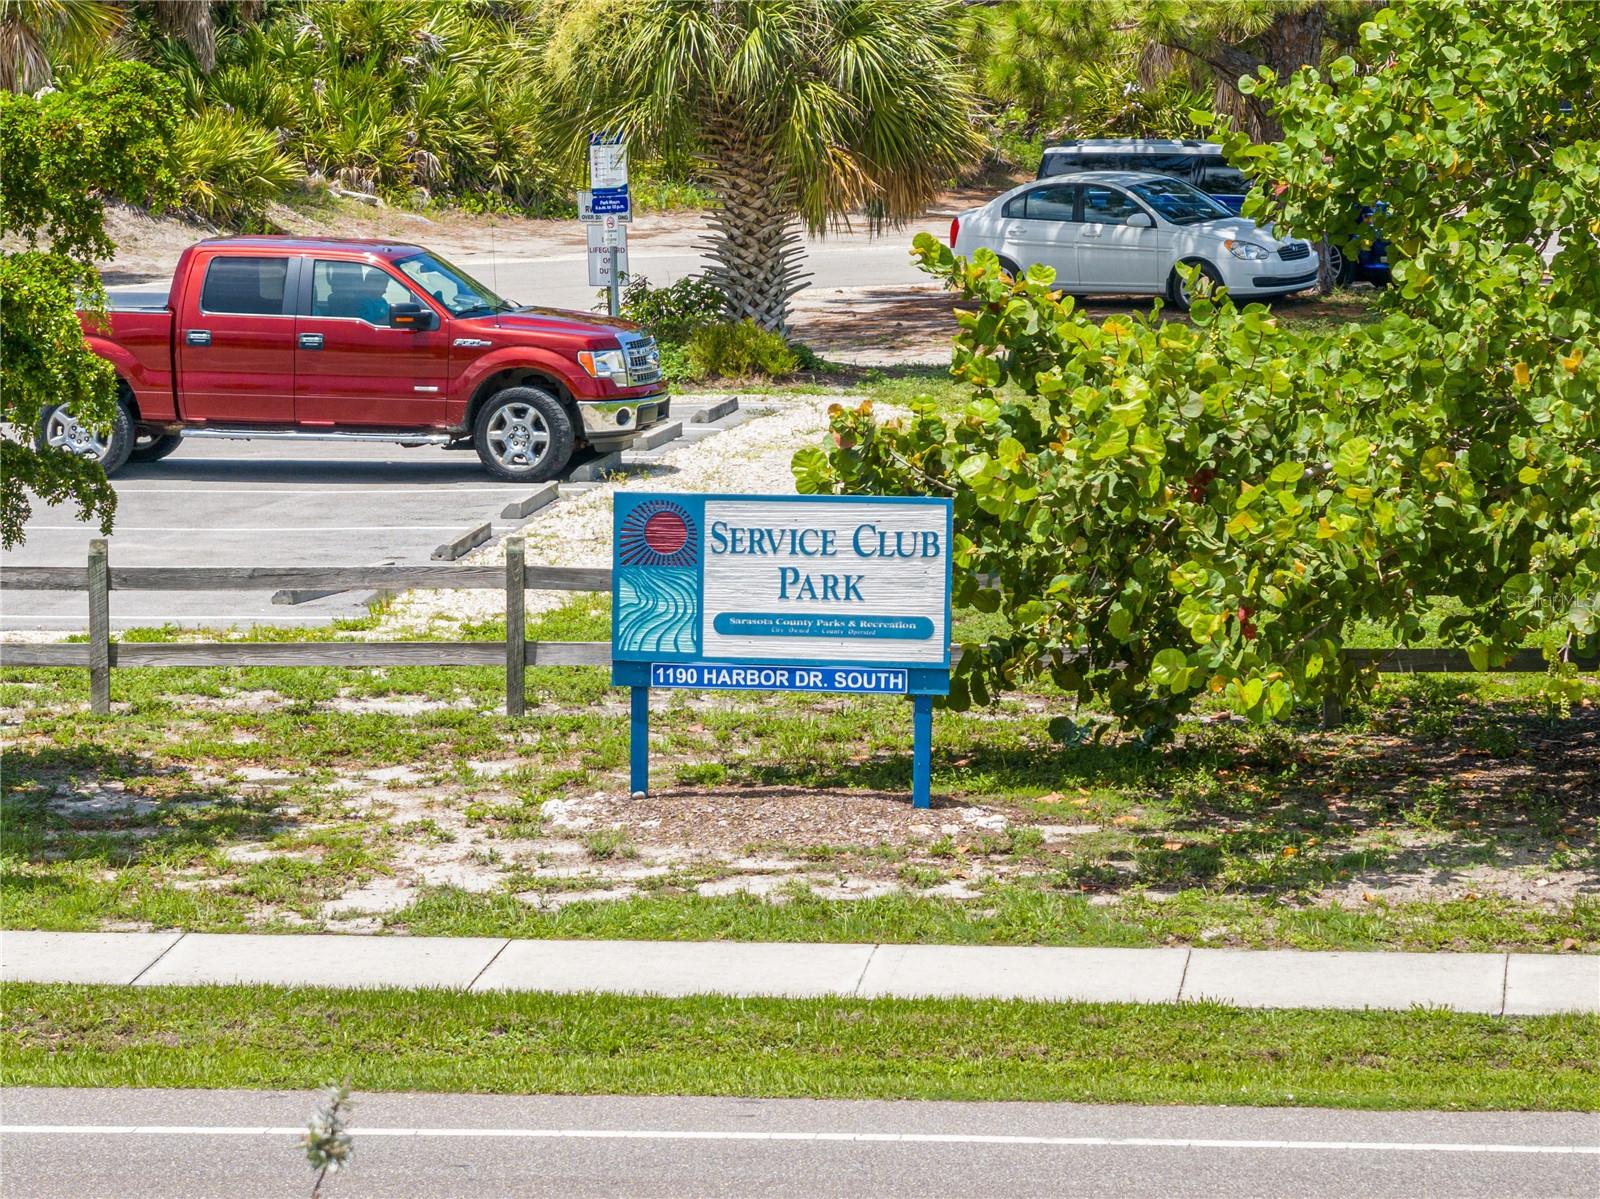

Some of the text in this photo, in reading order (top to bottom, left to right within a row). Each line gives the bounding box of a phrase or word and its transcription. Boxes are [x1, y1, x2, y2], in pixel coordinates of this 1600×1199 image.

[710, 521, 940, 558] SERVICE CLUB
[778, 567, 864, 601] PARK
[730, 617, 772, 625] Sarasota
[776, 618, 814, 627] County
[816, 619, 845, 627] Parks
[860, 620, 916, 630] Recreation
[656, 668, 903, 689] 1190 HARBOR DR. SOUTH
